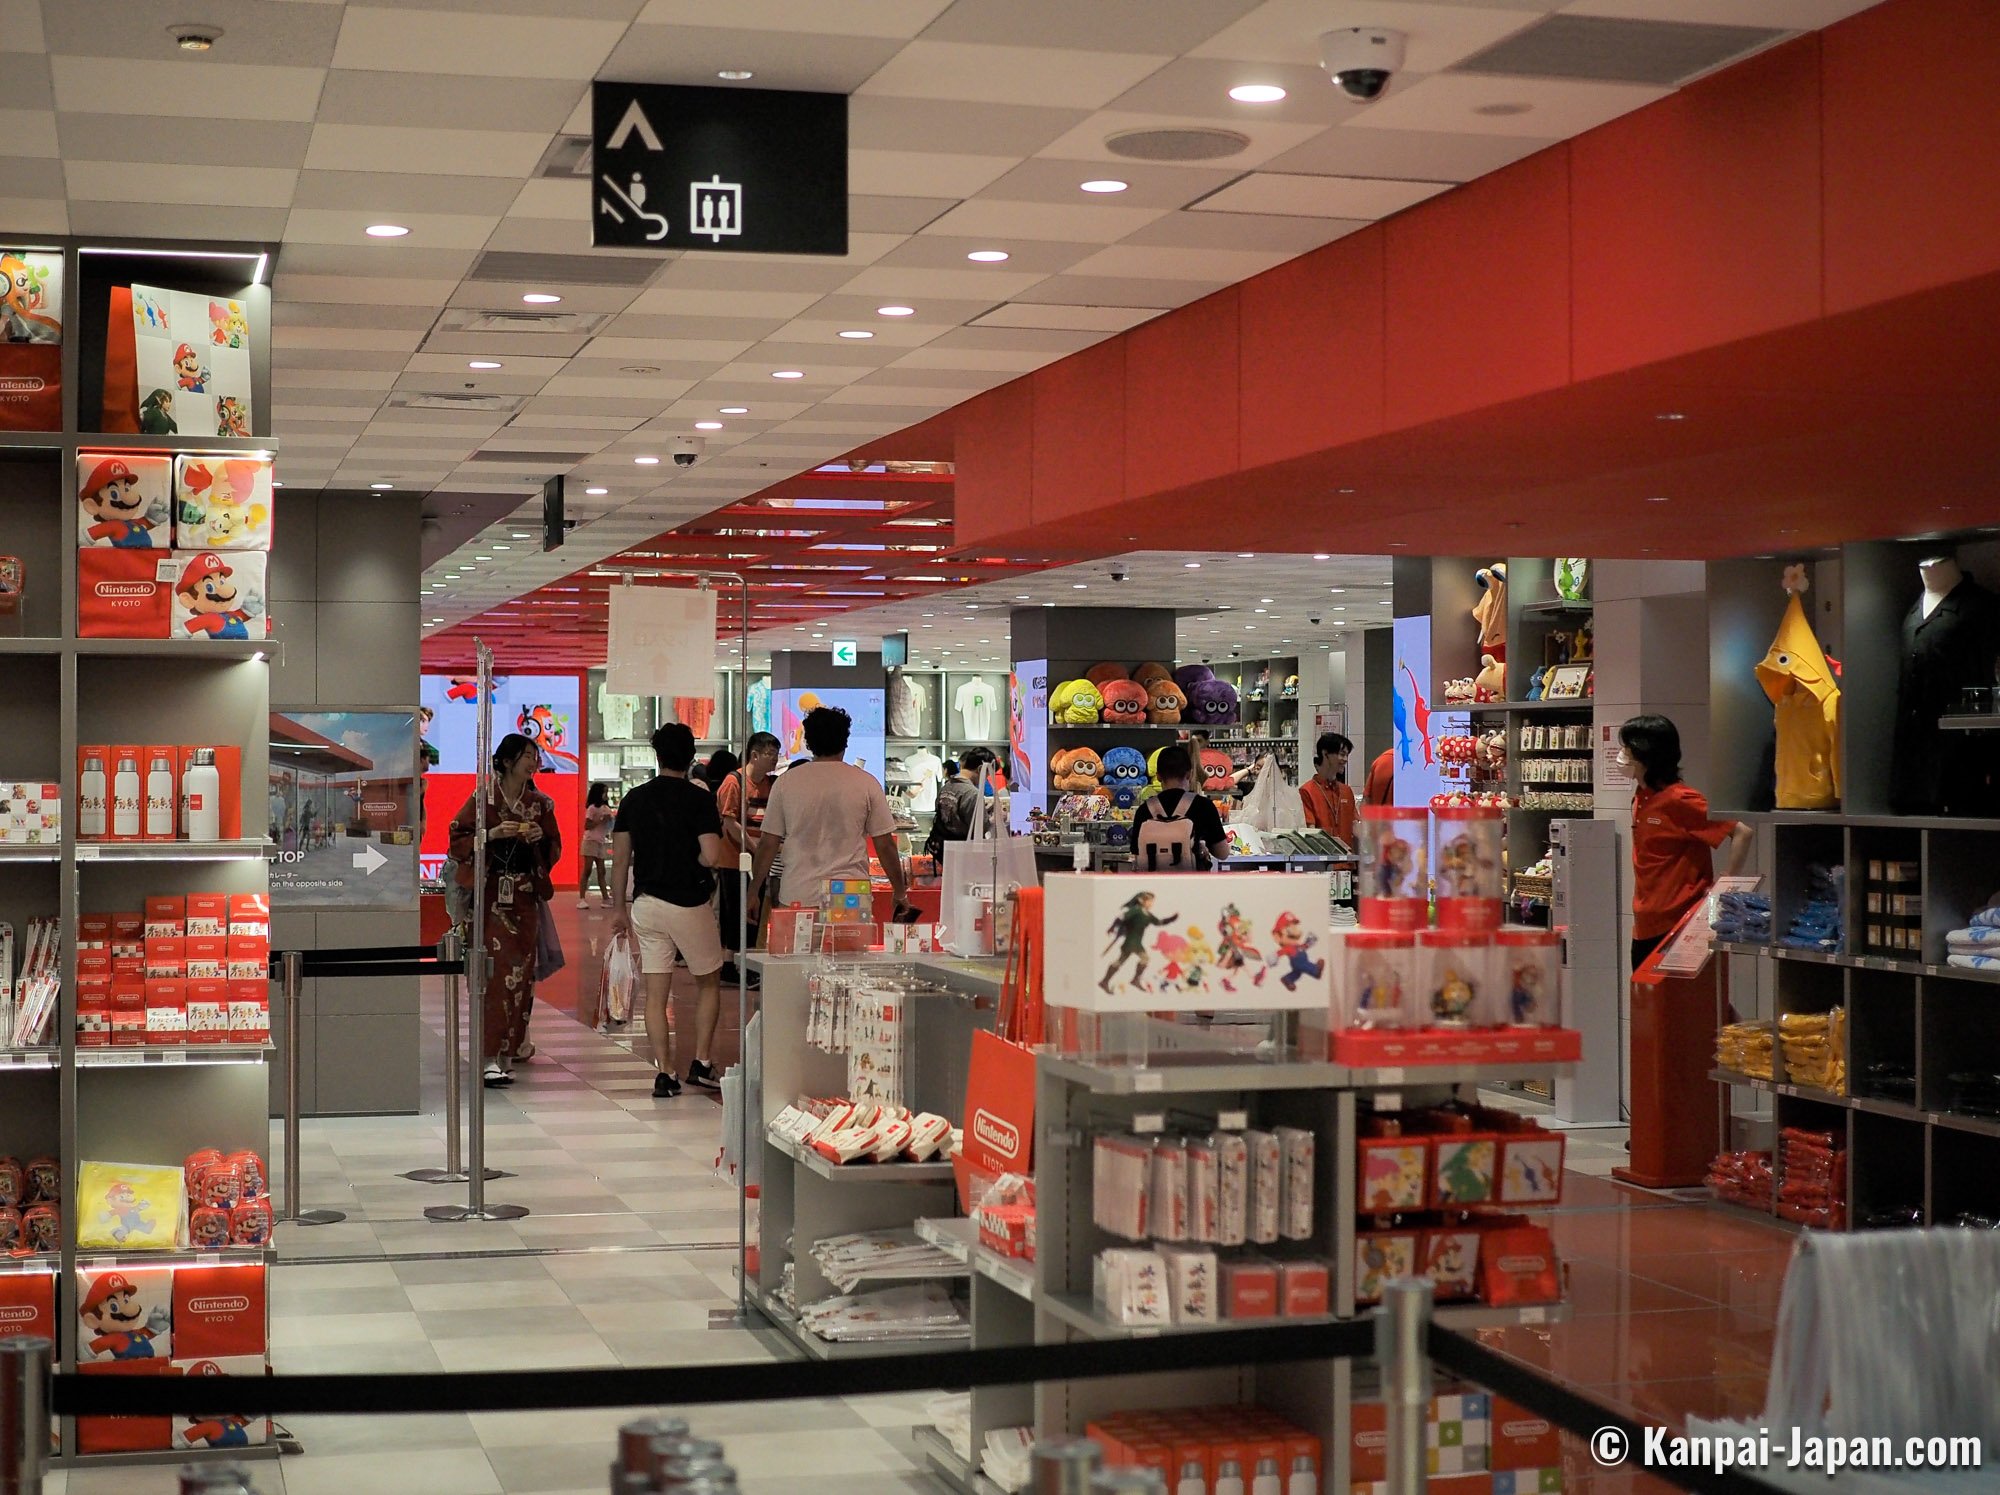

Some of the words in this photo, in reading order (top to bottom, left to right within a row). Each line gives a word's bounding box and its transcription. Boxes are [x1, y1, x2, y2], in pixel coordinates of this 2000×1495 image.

[100, 584, 151, 594] Nintendo
[282, 880, 294, 888] the
[295, 880, 327, 888] opposite
[976, 1115, 1016, 1152] Nintendo
[193, 1299, 244, 1310] Nintendo
[204, 1315, 234, 1323] KYOTO
